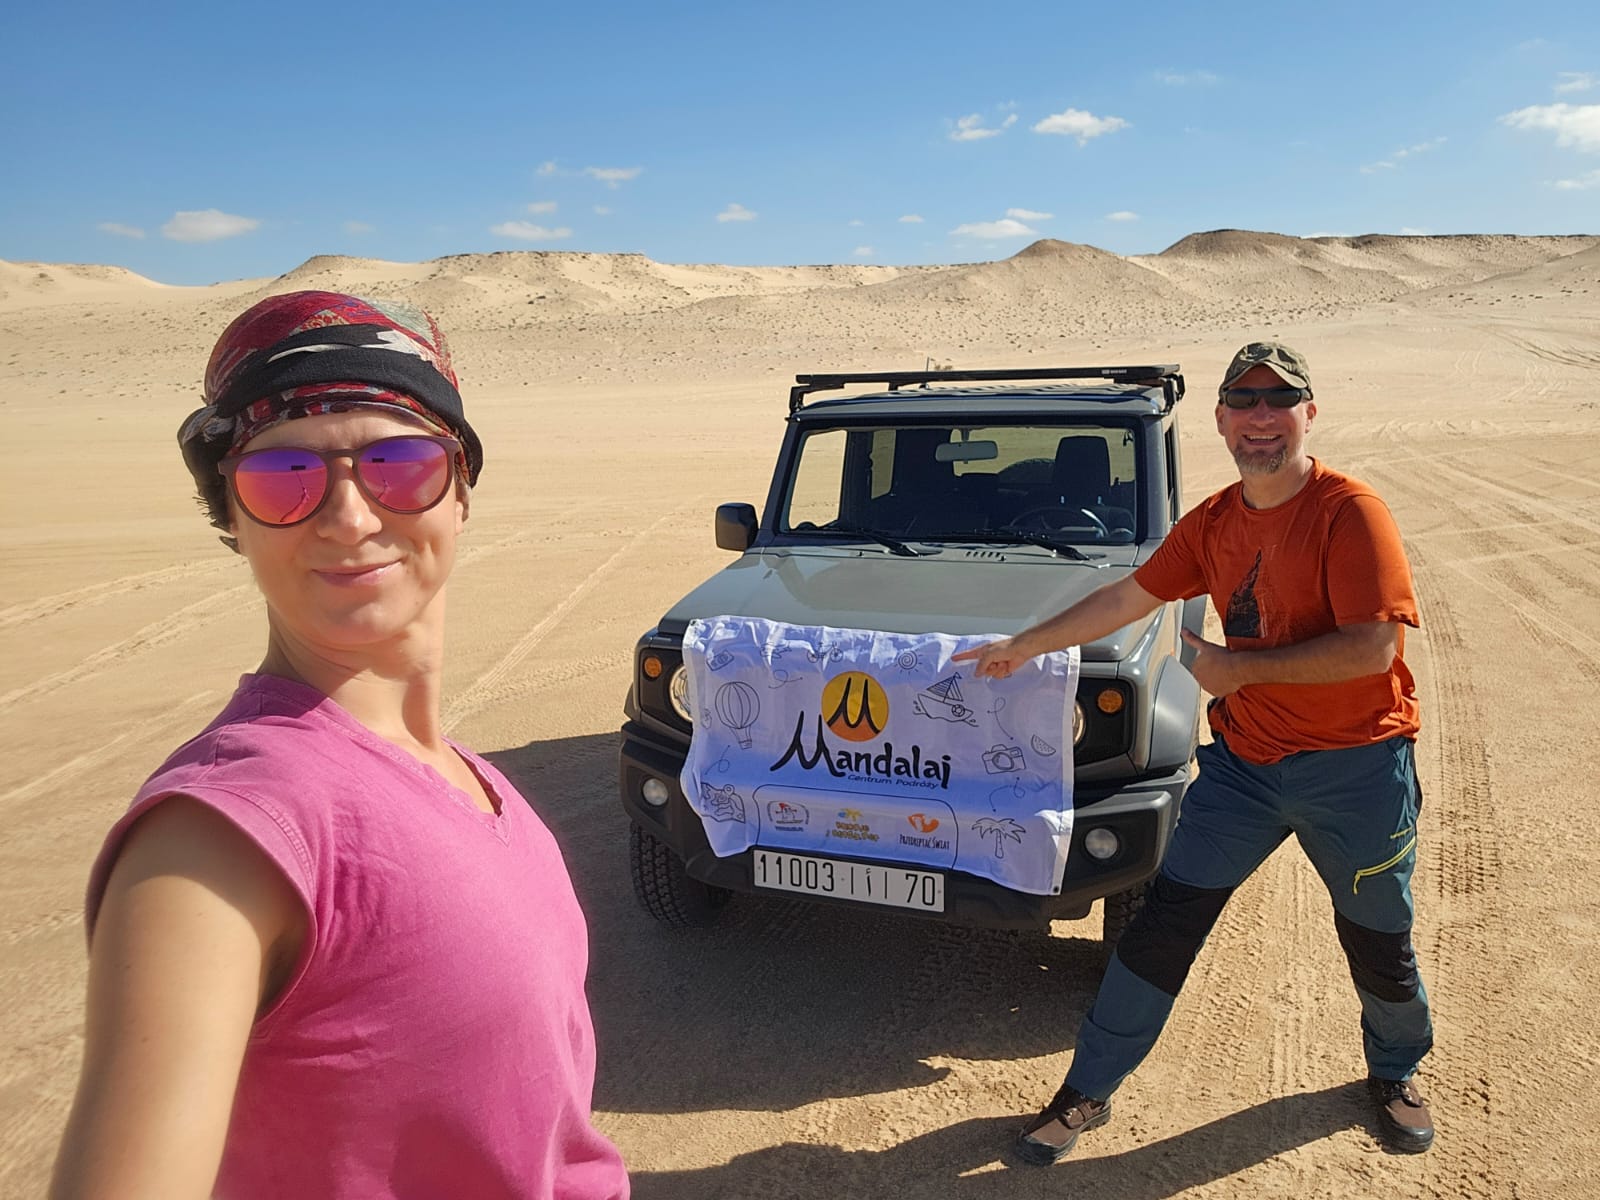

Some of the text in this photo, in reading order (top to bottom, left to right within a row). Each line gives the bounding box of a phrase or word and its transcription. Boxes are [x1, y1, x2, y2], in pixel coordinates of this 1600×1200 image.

[769, 710, 951, 789] Mandalaj
[848, 774, 939, 790] Centrum Podróży
[760, 854, 834, 892] 11003
[905, 873, 936, 906] 70
